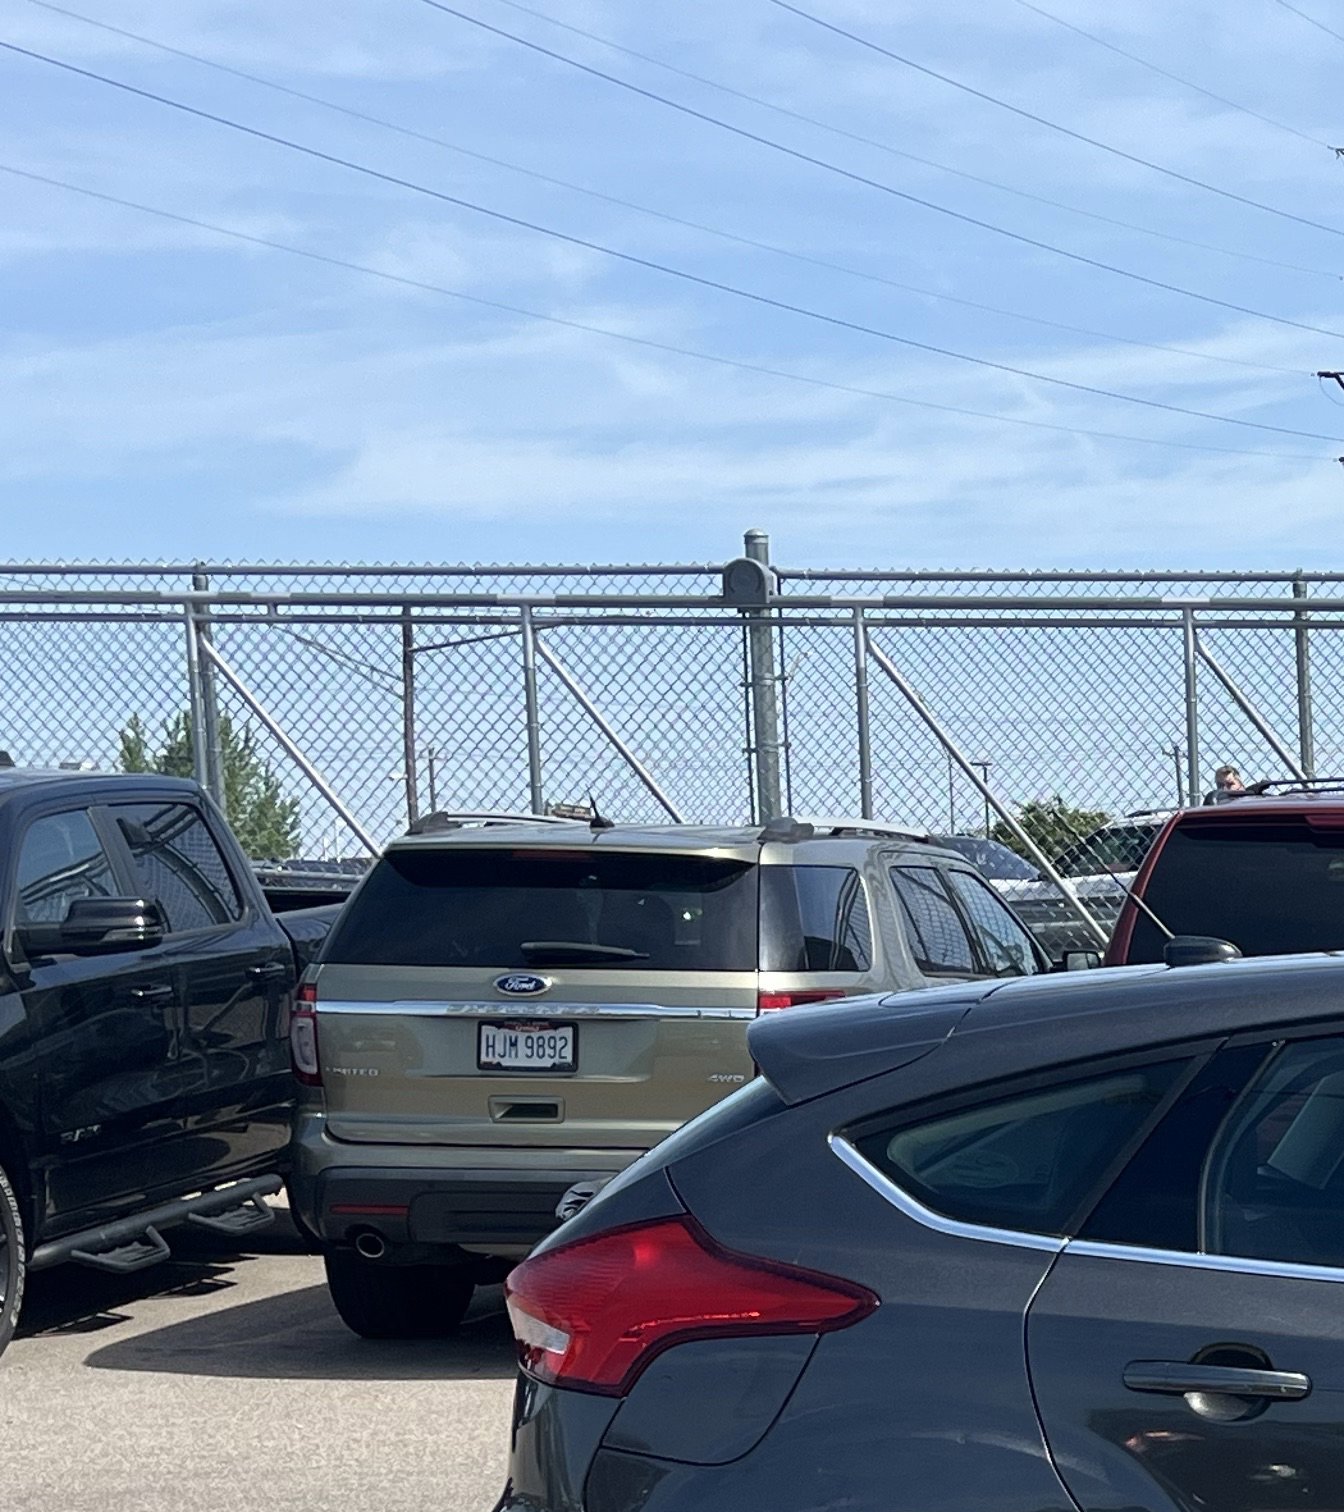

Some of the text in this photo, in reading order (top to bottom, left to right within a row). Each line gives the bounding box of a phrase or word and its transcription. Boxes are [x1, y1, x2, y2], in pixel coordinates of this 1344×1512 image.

[504, 976, 536, 990] Ford
[485, 1034, 568, 1059] HJM 9892
